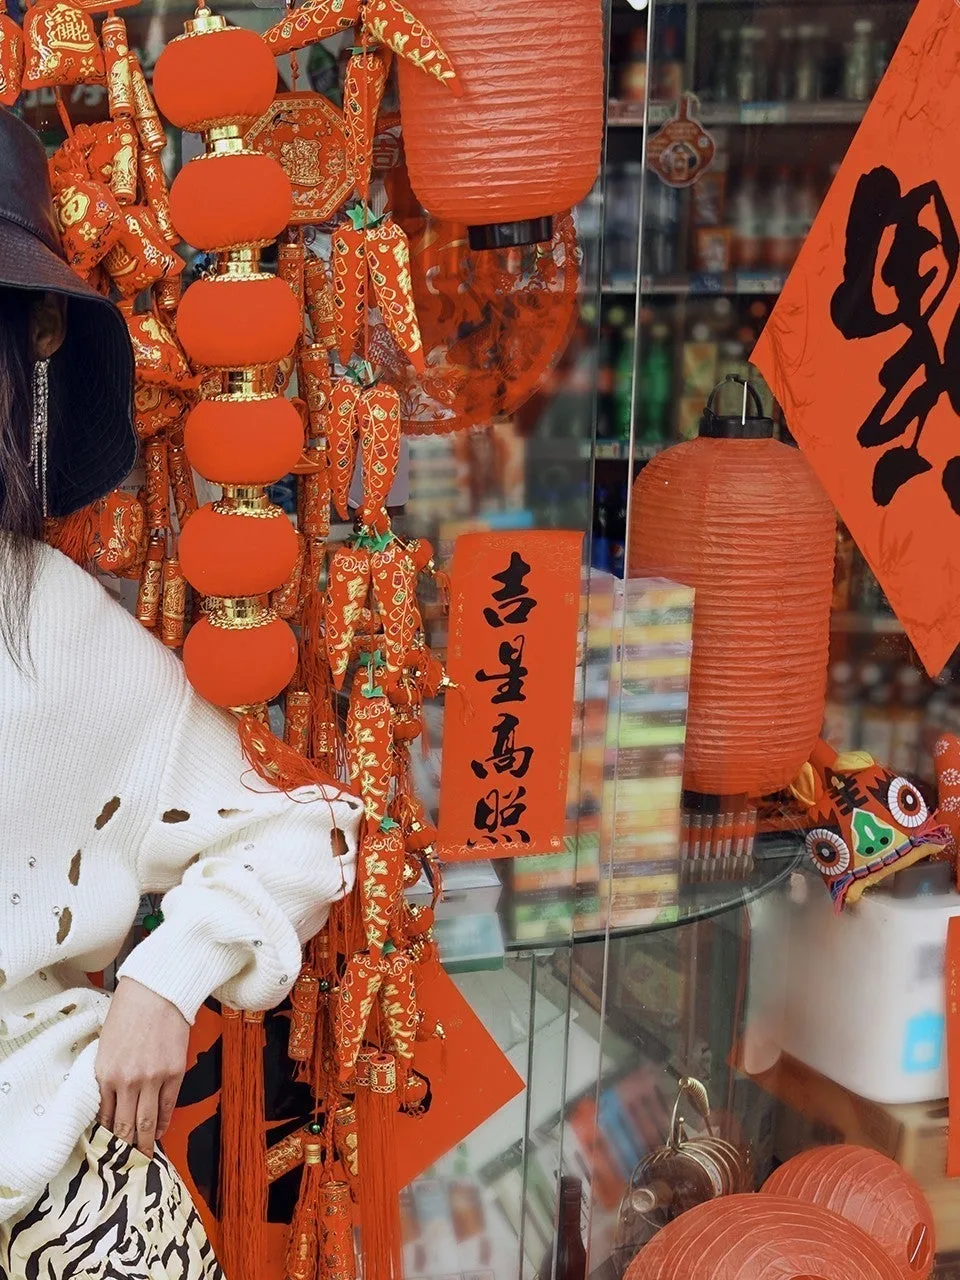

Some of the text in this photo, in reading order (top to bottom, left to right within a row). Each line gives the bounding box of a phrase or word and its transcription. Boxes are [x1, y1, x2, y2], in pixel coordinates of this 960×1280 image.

[466, 551, 538, 846] 吉星高照
[354, 721, 385, 822] 红红火火
[362, 851, 390, 949] 红红火火
